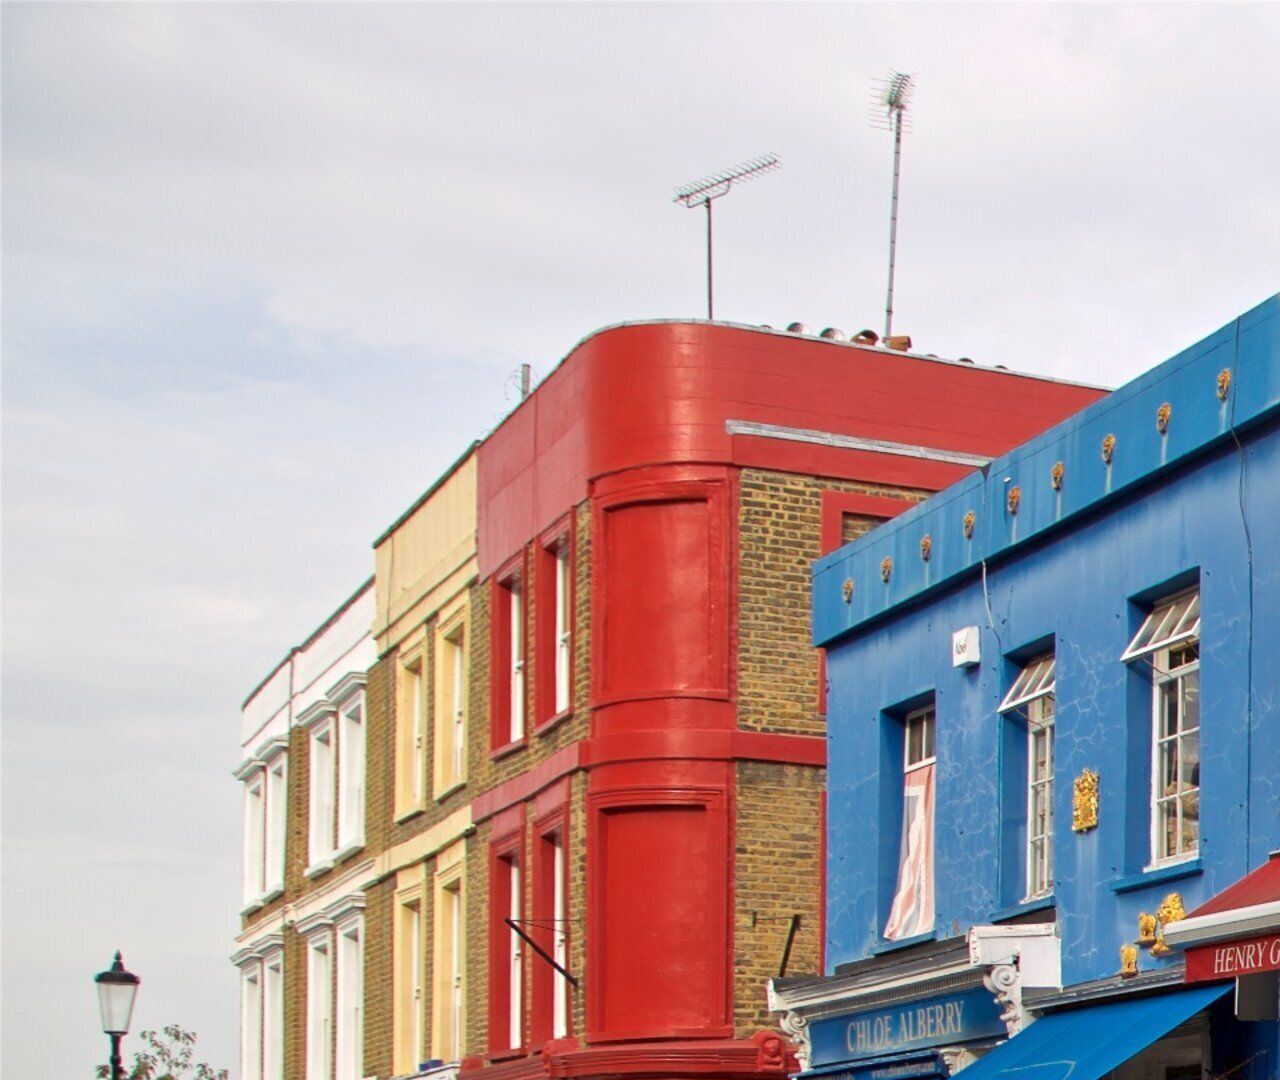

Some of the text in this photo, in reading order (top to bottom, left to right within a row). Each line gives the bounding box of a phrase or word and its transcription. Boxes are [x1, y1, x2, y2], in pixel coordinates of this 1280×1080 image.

[1214, 941, 1267, 974] HENRY
[847, 1000, 966, 1052] CHLOE ALBERRY
